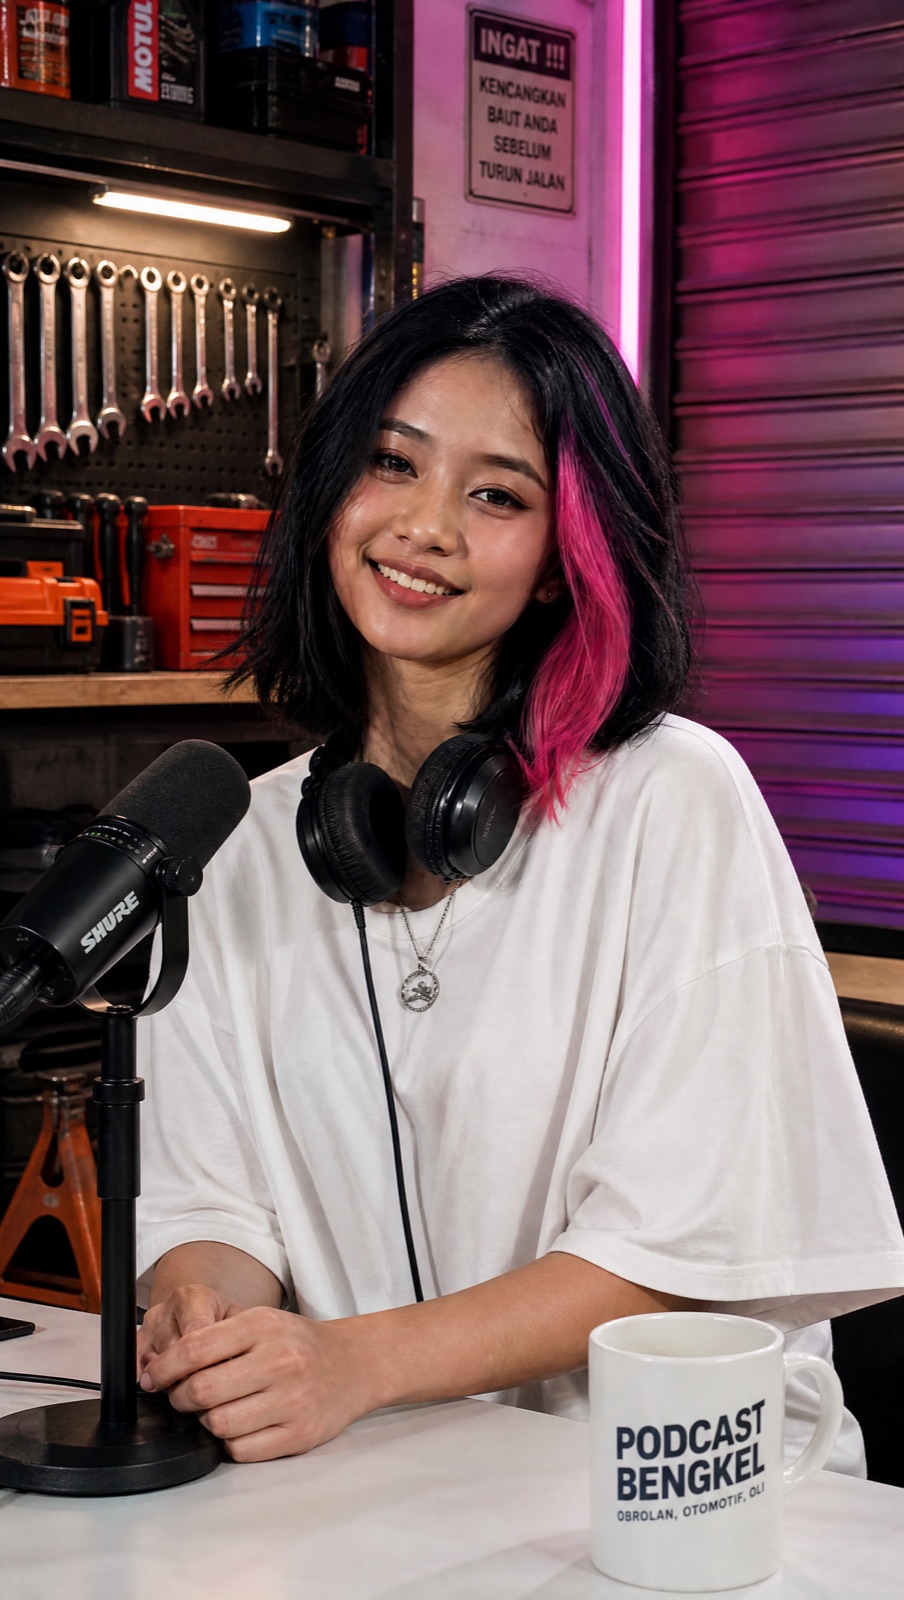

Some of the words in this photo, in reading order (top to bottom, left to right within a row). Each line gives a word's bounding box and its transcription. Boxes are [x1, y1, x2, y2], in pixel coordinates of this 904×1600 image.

[134, 0, 153, 94] MOTUL
[480, 28, 540, 64] INGAT
[479, 76, 566, 109] KENCANGKAN
[488, 106, 521, 128] BAUT
[524, 113, 558, 135] ANDA
[494, 135, 551, 161] SEBELUM
[479, 161, 522, 184] TURUN
[525, 170, 565, 191] JALAN
[80, 891, 140, 954] SHURE
[616, 1399, 766, 1460] PODCAST
[617, 1442, 765, 1501] BENGKEL
[617, 1509, 678, 1522] OBROLAN,
[683, 1492, 746, 1517] OTOMOTIF,
[750, 1482, 765, 1498] OLI
